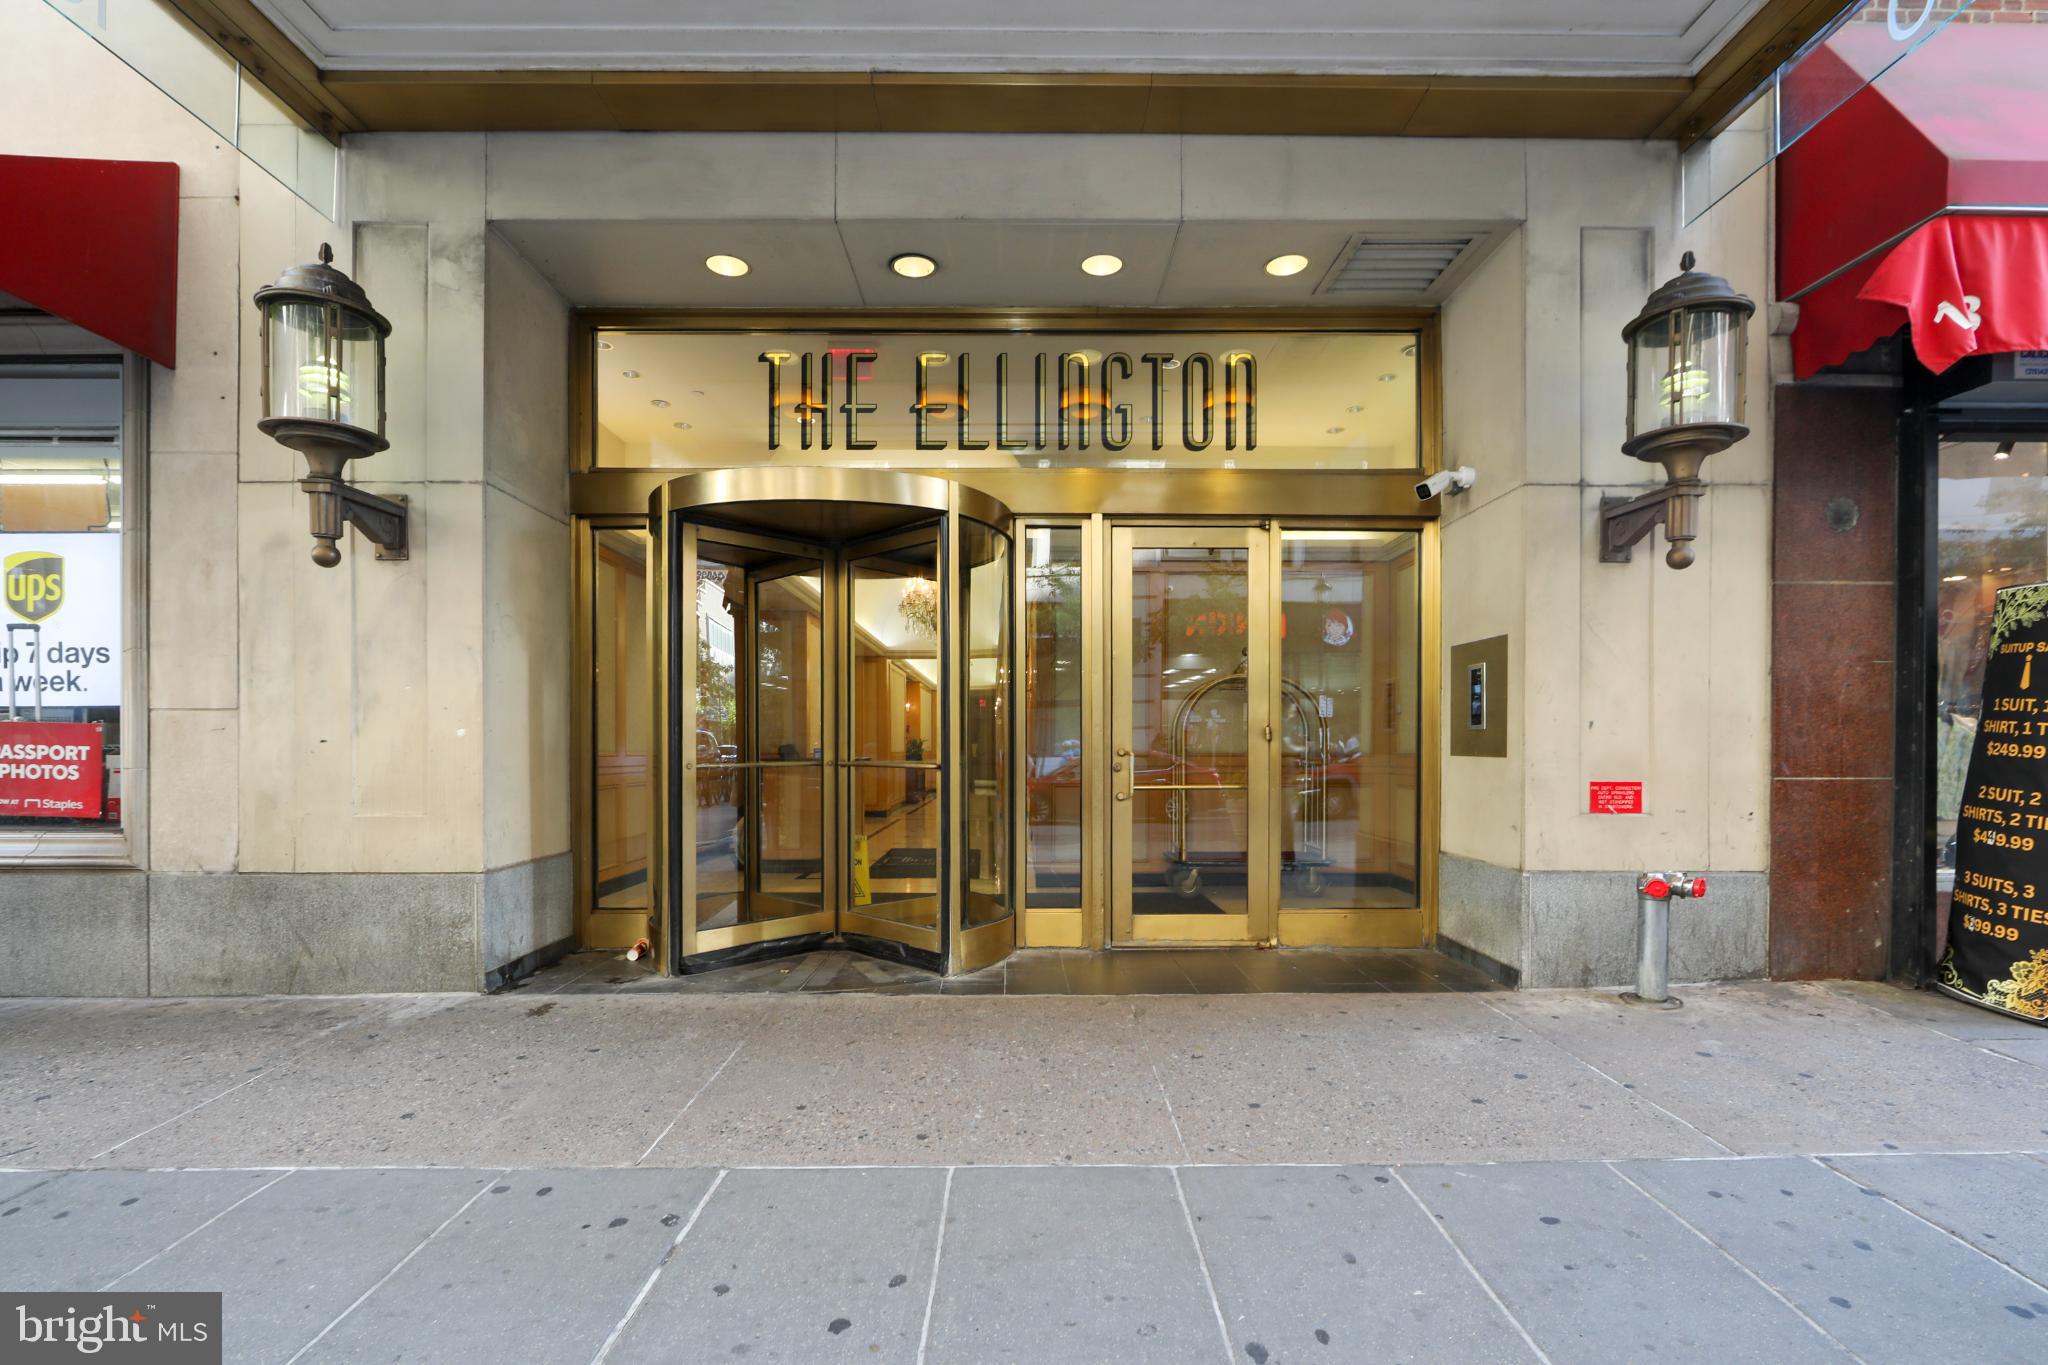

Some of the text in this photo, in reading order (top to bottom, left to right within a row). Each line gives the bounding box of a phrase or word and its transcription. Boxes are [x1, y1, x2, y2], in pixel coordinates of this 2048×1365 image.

[758, 352, 1258, 452] THE ELLINGTON
[8, 573, 61, 612] ups
[0, 647, 19, 669] p
[47, 641, 110, 668] days
[14, 669, 88, 692] week.
[1983, 719, 2020, 737] SHIRT,
[2022, 721, 2033, 735] 1
[0, 744, 91, 761] ASSPORT
[1986, 742, 2047, 759] $249.99
[0, 763, 80, 781] PHOTOS
[42, 799, 84, 812] Staples
[2029, 791, 2042, 806] 2
[1962, 804, 2006, 827] SHIRTS,
[2009, 812, 2021, 826] 2
[2022, 884, 2036, 899] 3
[1953, 889, 1993, 916] SHIRTS,
[1997, 902, 2008, 916] 3
